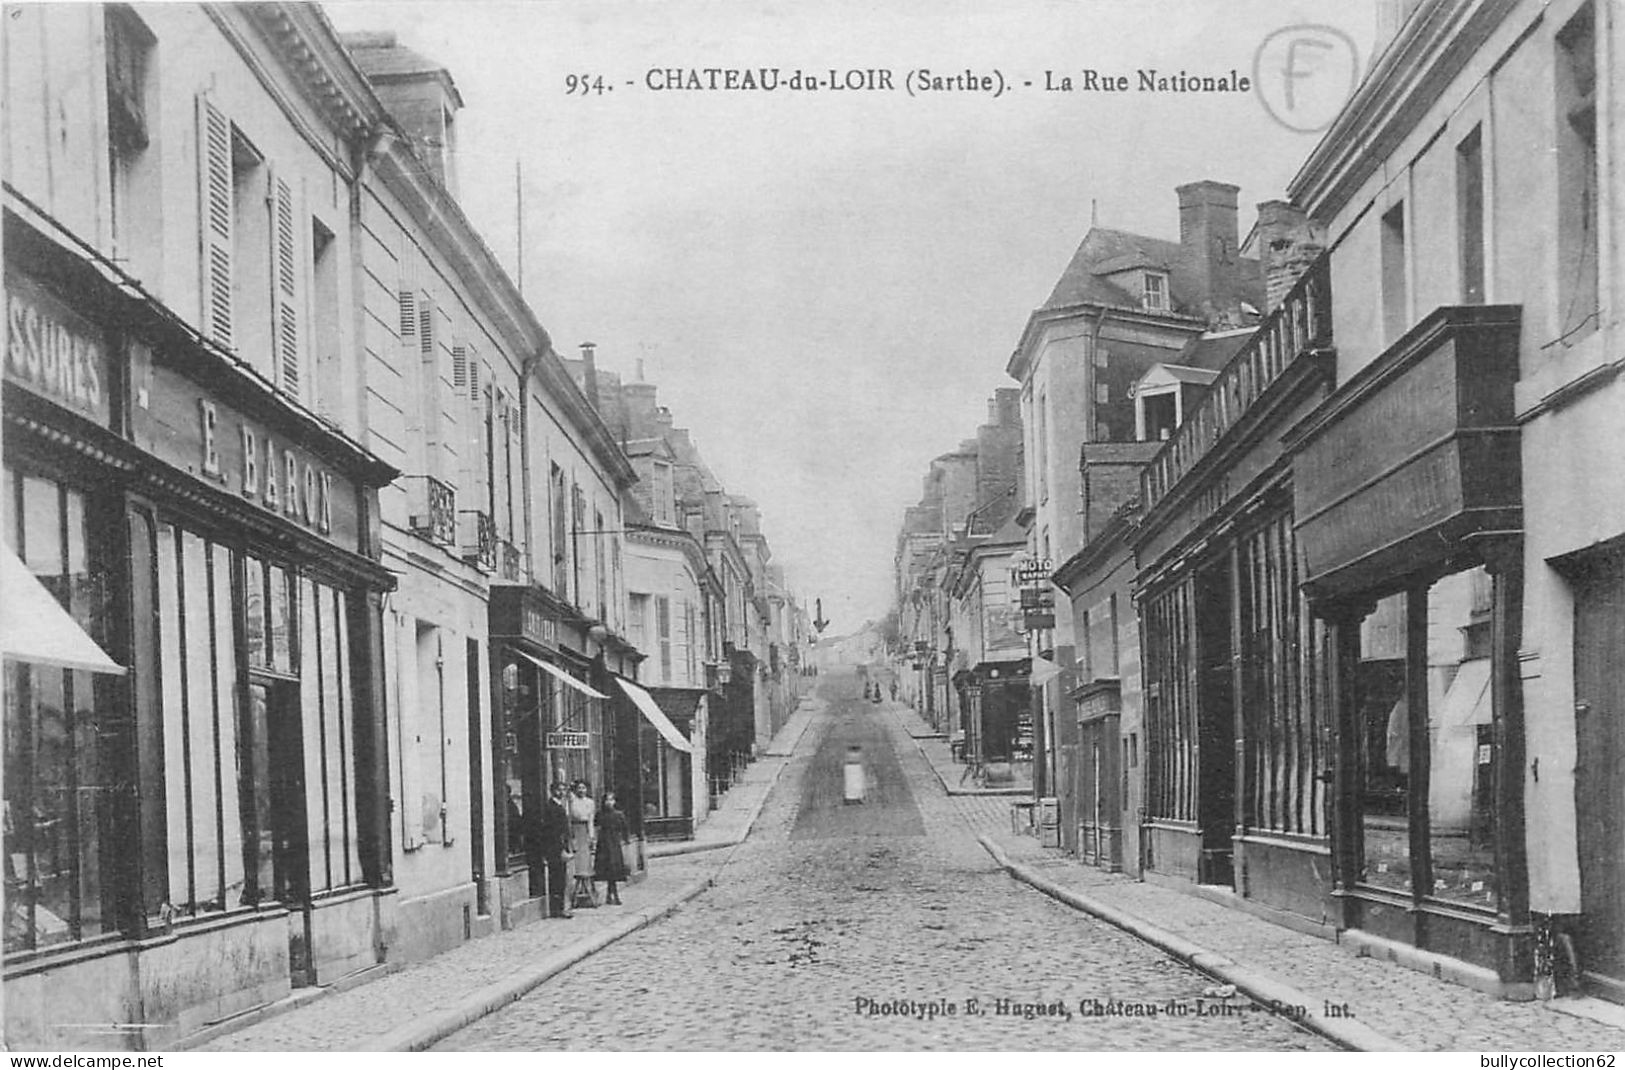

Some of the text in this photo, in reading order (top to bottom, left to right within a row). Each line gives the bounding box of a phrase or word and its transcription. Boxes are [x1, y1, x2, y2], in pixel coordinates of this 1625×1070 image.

[1281, 38, 1334, 110] F
[243, 424, 332, 534] BARON
[1020, 560, 1052, 571] MOTO
